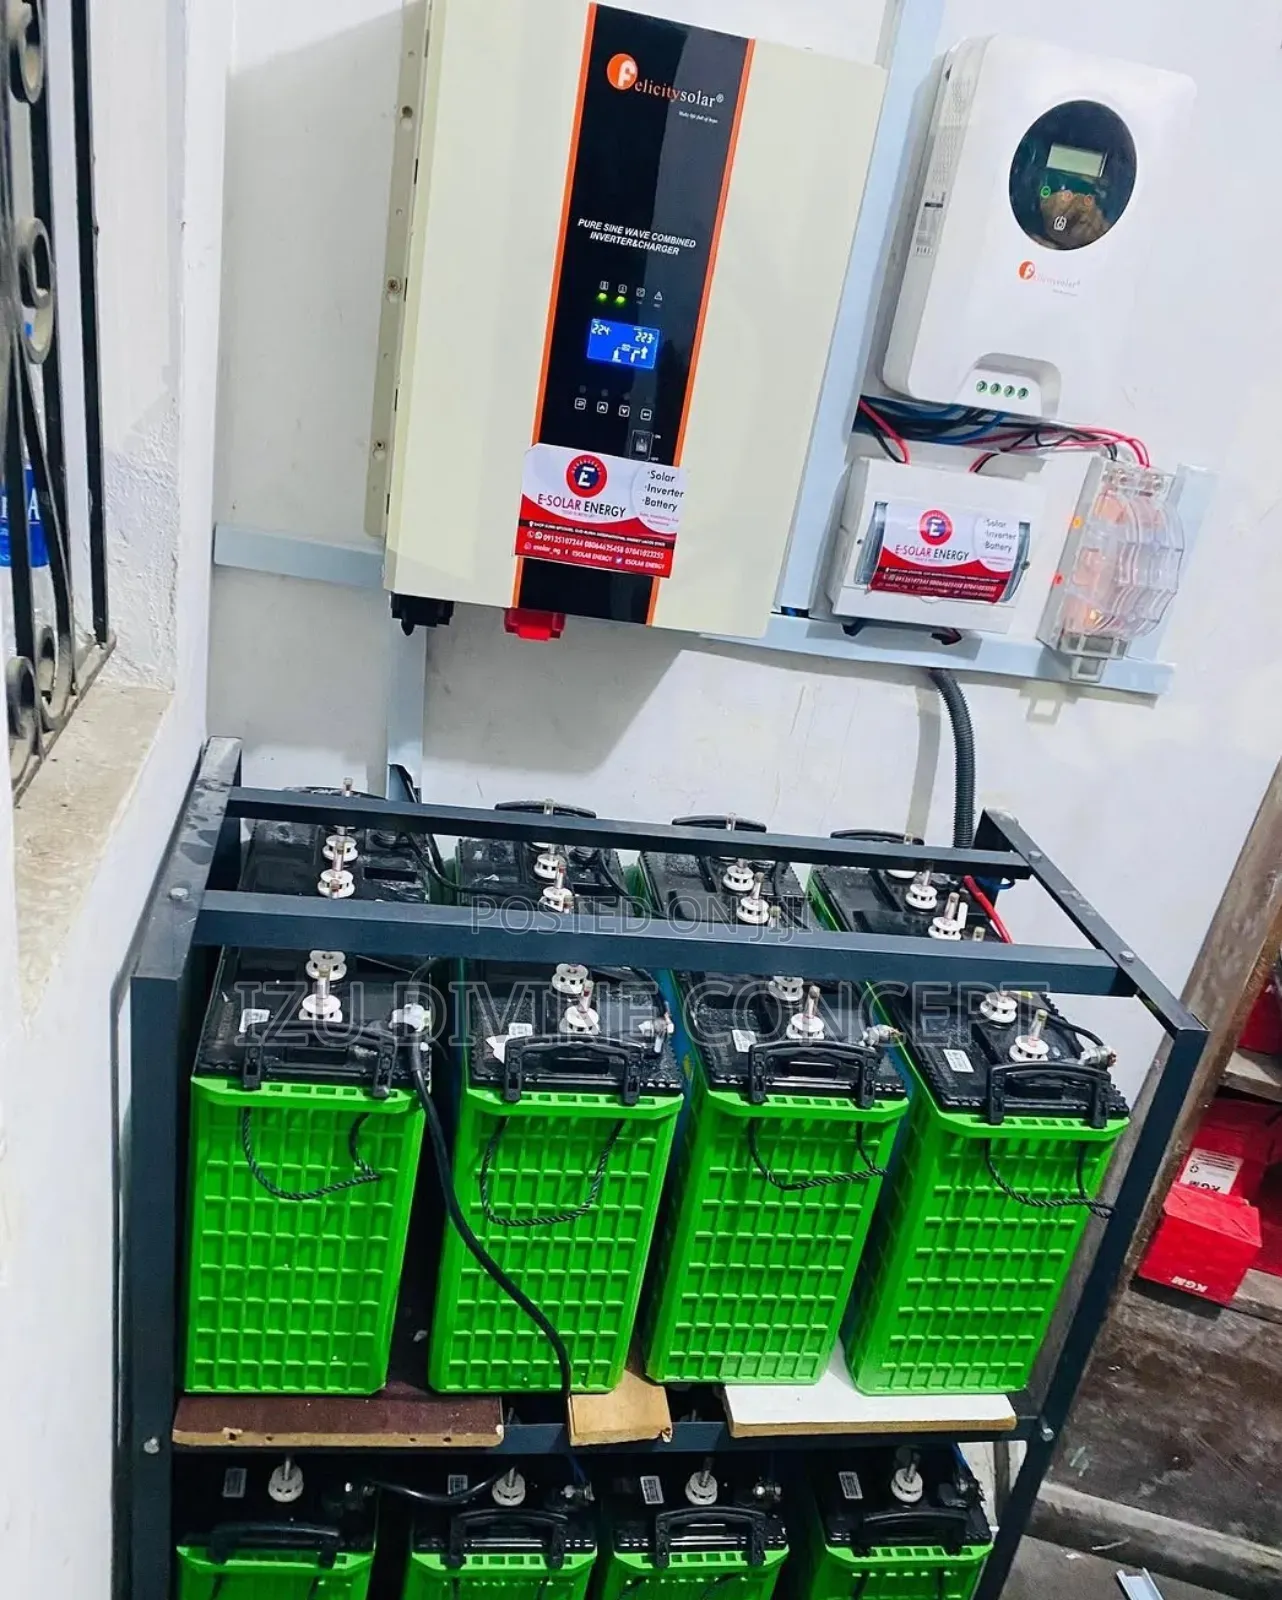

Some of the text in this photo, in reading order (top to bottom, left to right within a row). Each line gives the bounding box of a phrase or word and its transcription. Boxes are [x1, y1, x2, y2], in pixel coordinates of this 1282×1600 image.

[577, 218, 696, 248] PURE SINE WAVE COMBINED
[590, 231, 680, 255] INVERTER&CHARGER
[650, 470, 675, 483] Solar
[647, 484, 684, 498] Inverter
[537, 493, 581, 511] E-SOLAR
[584, 501, 626, 518] ENERGY
[645, 498, 678, 512] Battery
[986, 530, 1017, 540] Inverter
[895, 544, 931, 557] E-SOLAR
[933, 548, 969, 561] ENERGY
[984, 541, 1012, 553] Battery
